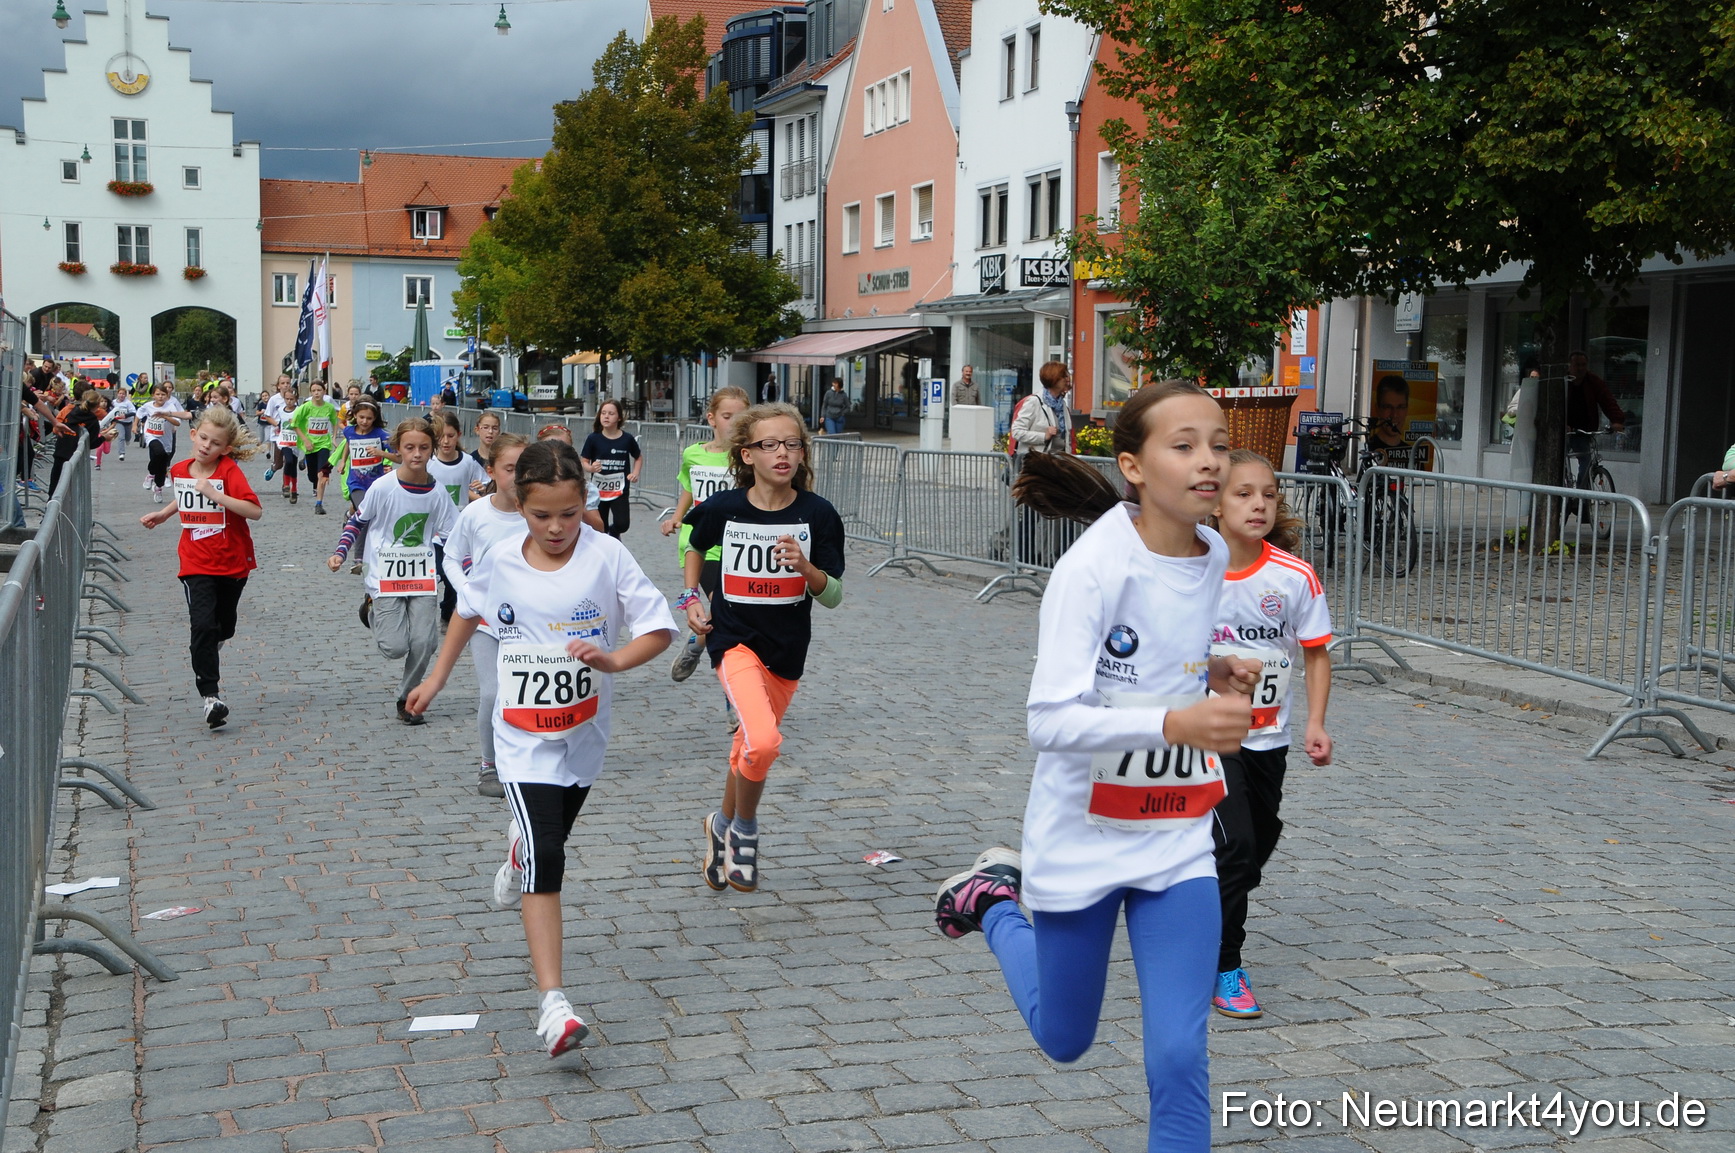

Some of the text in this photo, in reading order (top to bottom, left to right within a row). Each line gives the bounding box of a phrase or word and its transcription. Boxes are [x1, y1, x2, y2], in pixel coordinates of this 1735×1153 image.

[982, 256, 1002, 278] KBK
[1024, 260, 1070, 276] KBK
[934, 384, 941, 394] P
[311, 422, 328, 430] 7277
[596, 480, 621, 491] 7299
[178, 491, 218, 510] 7014
[184, 514, 206, 522] Marie
[726, 530, 750, 540] PARTL
[384, 559, 426, 577] 7011
[748, 582, 780, 597] Katja
[498, 627, 522, 635] PARTL
[503, 655, 534, 664] PARTL
[1097, 656, 1138, 676] PARTL
[512, 666, 592, 705] 7286
[536, 712, 574, 728] Lucia
[1140, 792, 1186, 813] Julia
